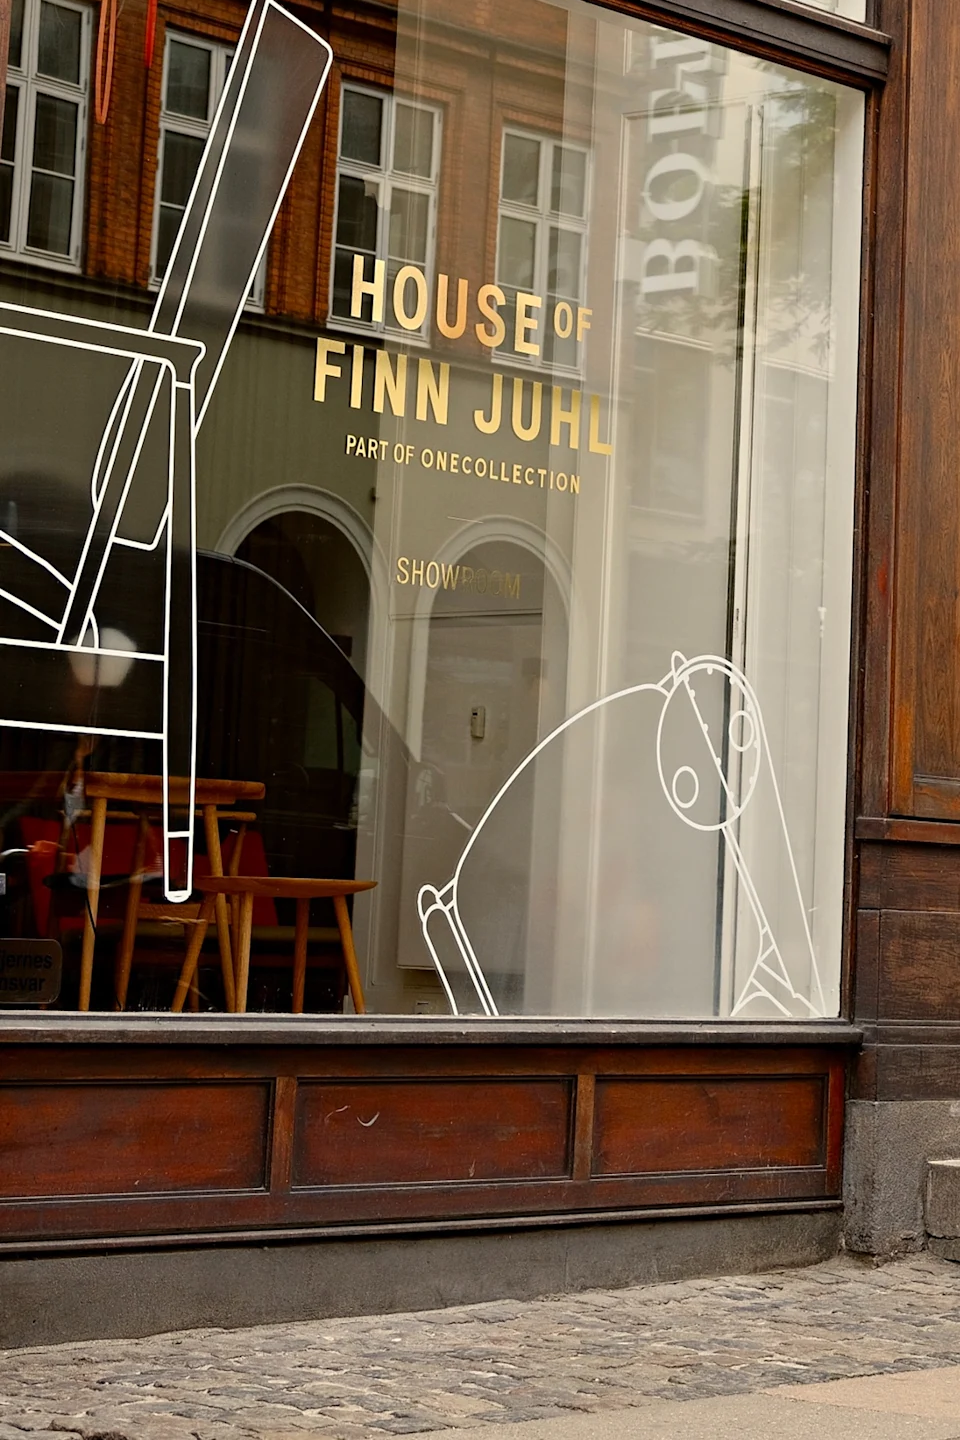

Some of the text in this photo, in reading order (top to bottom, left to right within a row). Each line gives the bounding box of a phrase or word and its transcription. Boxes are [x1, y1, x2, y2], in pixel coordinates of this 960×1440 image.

[350, 254, 593, 356] HOUSE OF
[313, 336, 612, 456] FINN JUHL
[345, 434, 581, 494] PART OF ONECOLLECTION
[396, 556, 521, 599] SHOWROOM
[0, 977, 46, 991] nsvar
